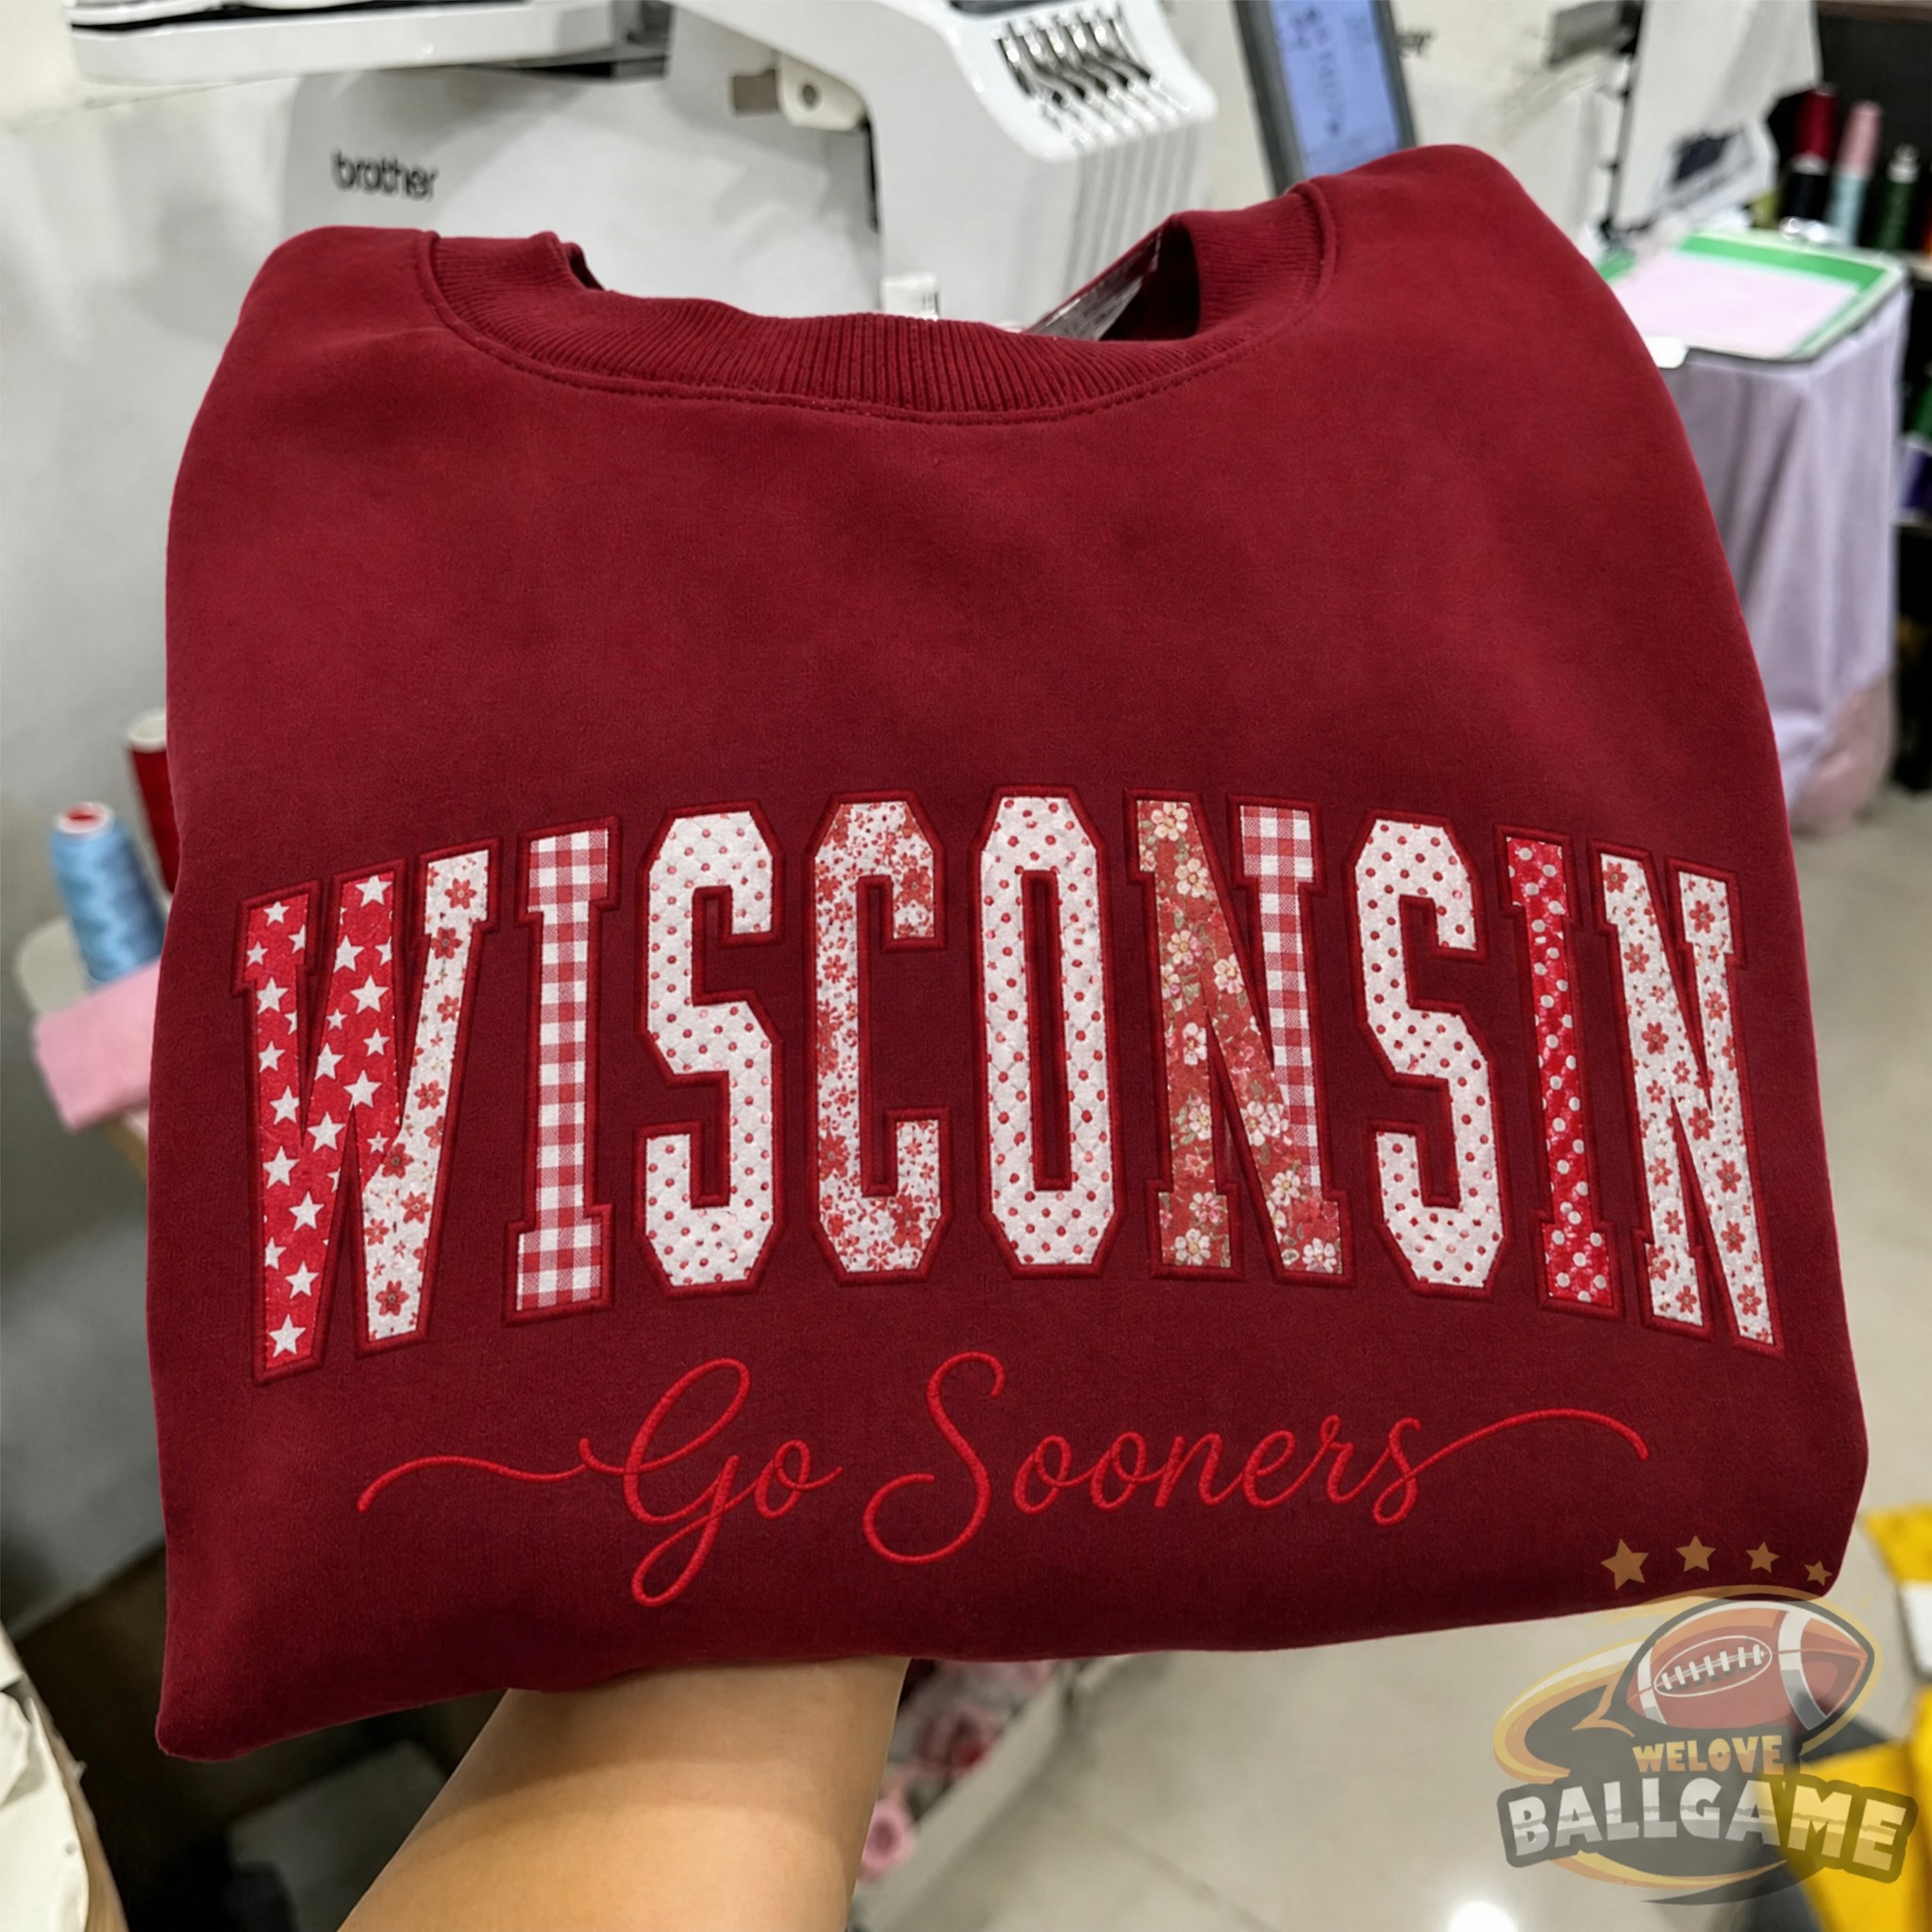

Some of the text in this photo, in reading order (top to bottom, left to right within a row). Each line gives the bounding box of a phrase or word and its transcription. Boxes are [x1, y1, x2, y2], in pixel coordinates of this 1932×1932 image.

[330, 148, 438, 200] brother
[233, 786, 1786, 1383] WISCONSIN
[577, 1351, 1423, 1606] Go Sooners
